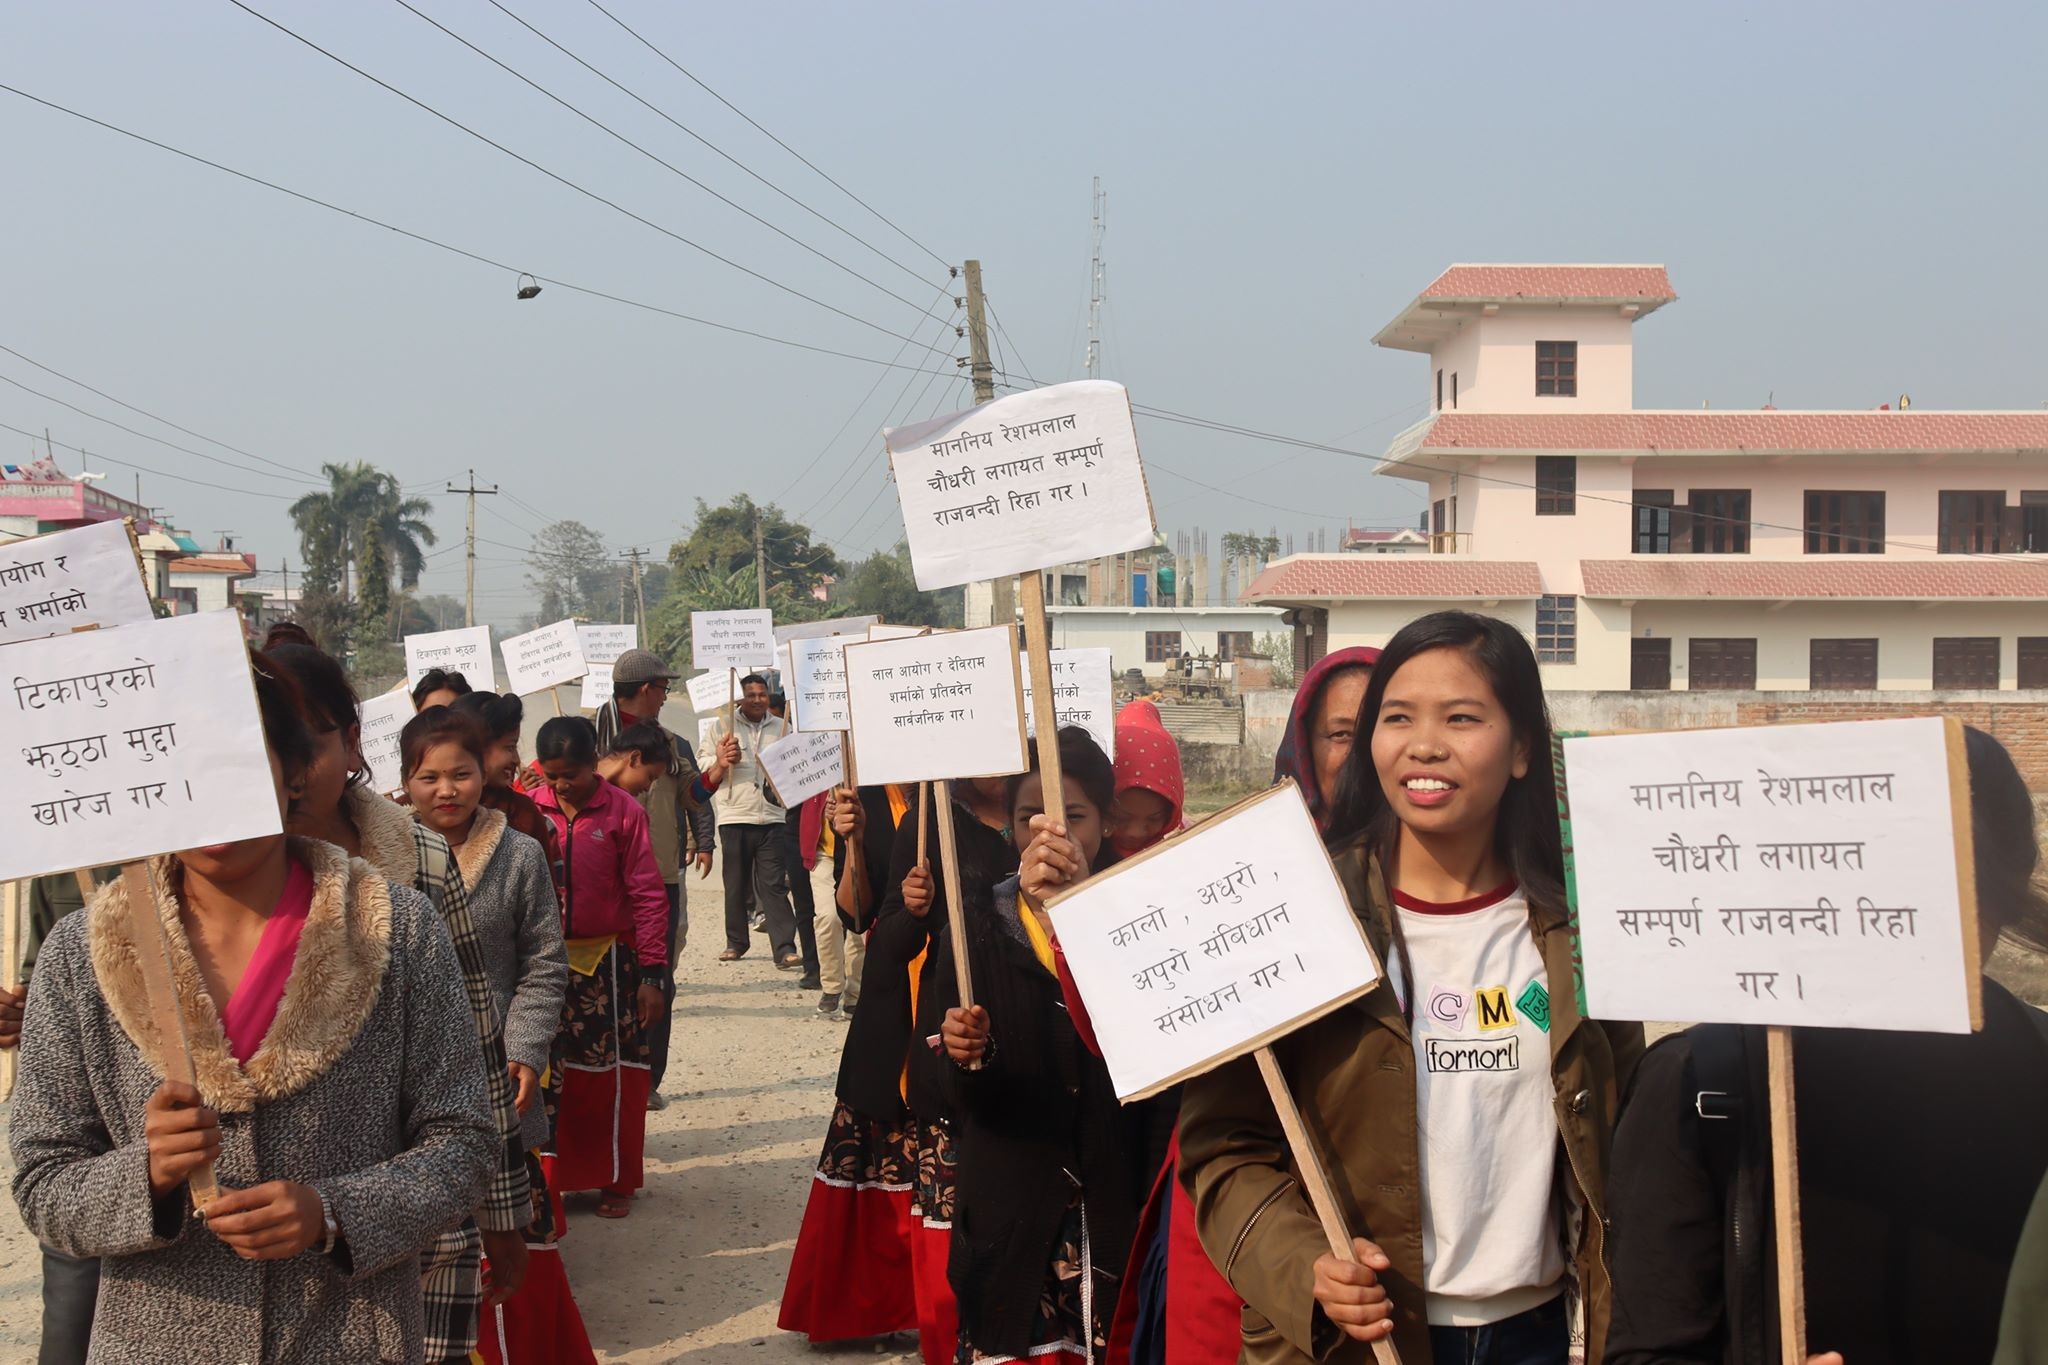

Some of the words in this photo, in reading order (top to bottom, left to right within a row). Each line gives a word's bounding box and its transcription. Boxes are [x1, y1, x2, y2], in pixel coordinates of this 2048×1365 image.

[929, 431, 993, 457] माननिय
[999, 414, 1076, 443] रेशमलाल
[926, 466, 975, 492] चौधरी
[984, 456, 1044, 480] लगायत
[1053, 437, 1103, 467] सम्पूर्ण
[933, 495, 1000, 526] राजवन्दी
[1008, 490, 1040, 511] रिहा
[55, 556, 70, 573] र
[16, 589, 87, 623] शर्माको
[13, 658, 155, 710] टिकापुरको
[872, 668, 893, 680] लाल
[900, 661, 931, 677] आयोग
[936, 662, 942, 672] र
[948, 656, 985, 671] देविराम
[1069, 662, 1076, 673] र
[828, 691, 847, 701] राजव
[890, 686, 924, 703] शर्माको
[893, 709, 944, 727] सार्वजनिक
[123, 723, 176, 762] मुद्दा
[31, 790, 111, 825] खारेज
[1630, 771, 1743, 810] माननिय
[1757, 769, 1895, 805] रेशमलाल
[1652, 833, 1741, 873] चौधरी
[1756, 842, 1866, 870] लगायत
[1108, 904, 1168, 948] कालो
[1196, 861, 1256, 905] अधुरो
[1616, 897, 1703, 947] सम्पूर्ण
[1718, 897, 1840, 936] राजवन्दी
[1857, 896, 1918, 939] रिहा
[1132, 948, 1191, 991] अपुरो
[1154, 982, 1240, 1034] संसोधन
